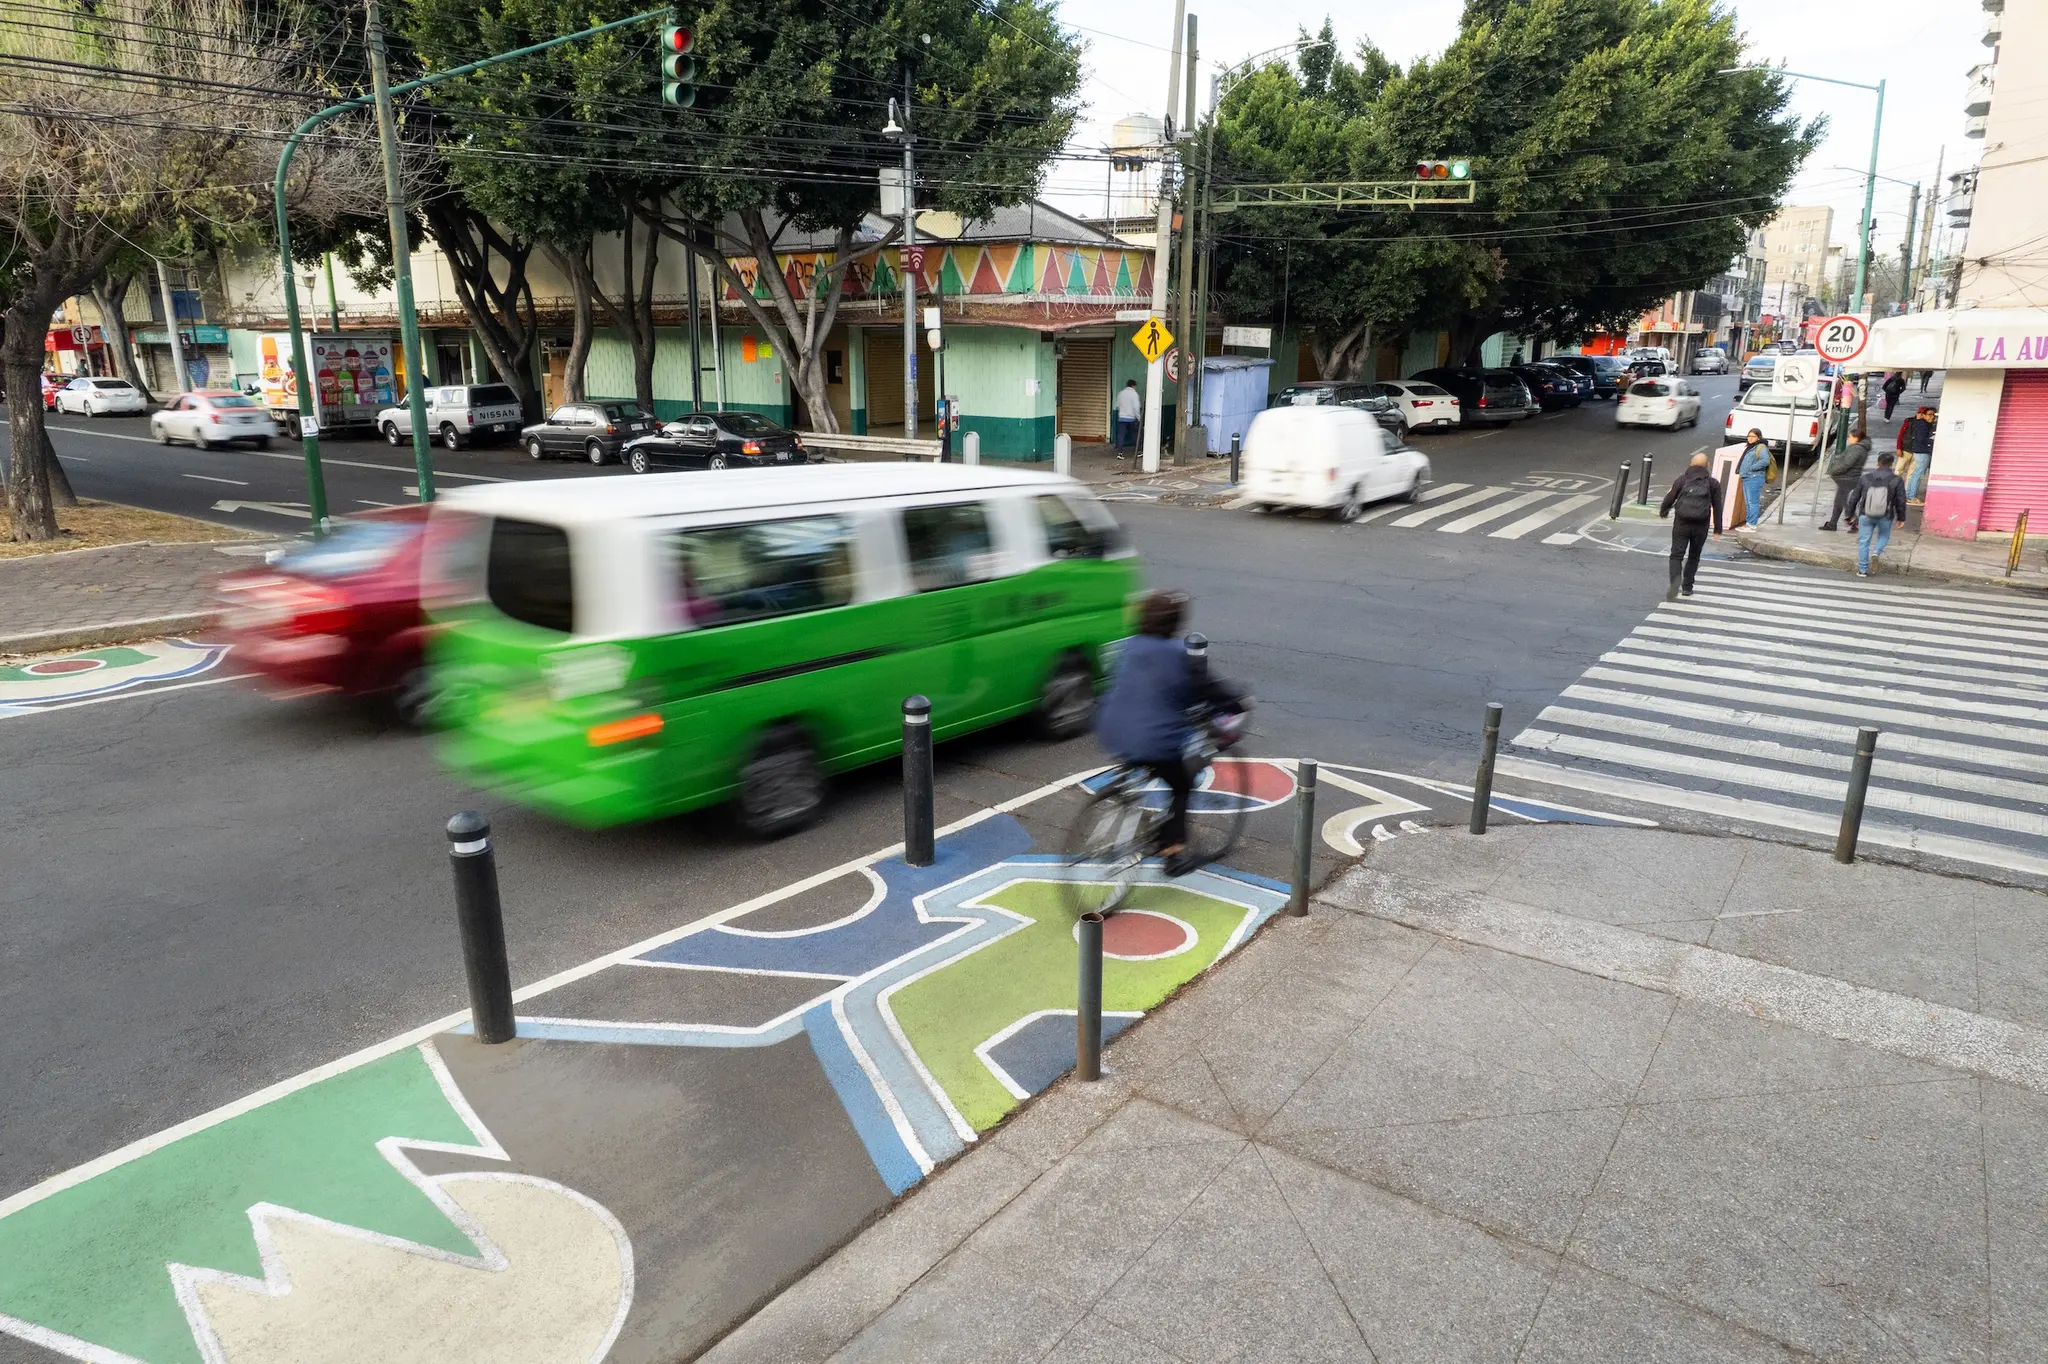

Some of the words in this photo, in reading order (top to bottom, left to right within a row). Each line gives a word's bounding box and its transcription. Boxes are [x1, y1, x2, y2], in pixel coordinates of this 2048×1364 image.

[1827, 325, 1856, 343] 20
[1824, 344, 1854, 354] km/h
[1972, 336, 2007, 361] LA
[479, 409, 515, 420] NISSAN
[1510, 475, 1592, 490] 30
